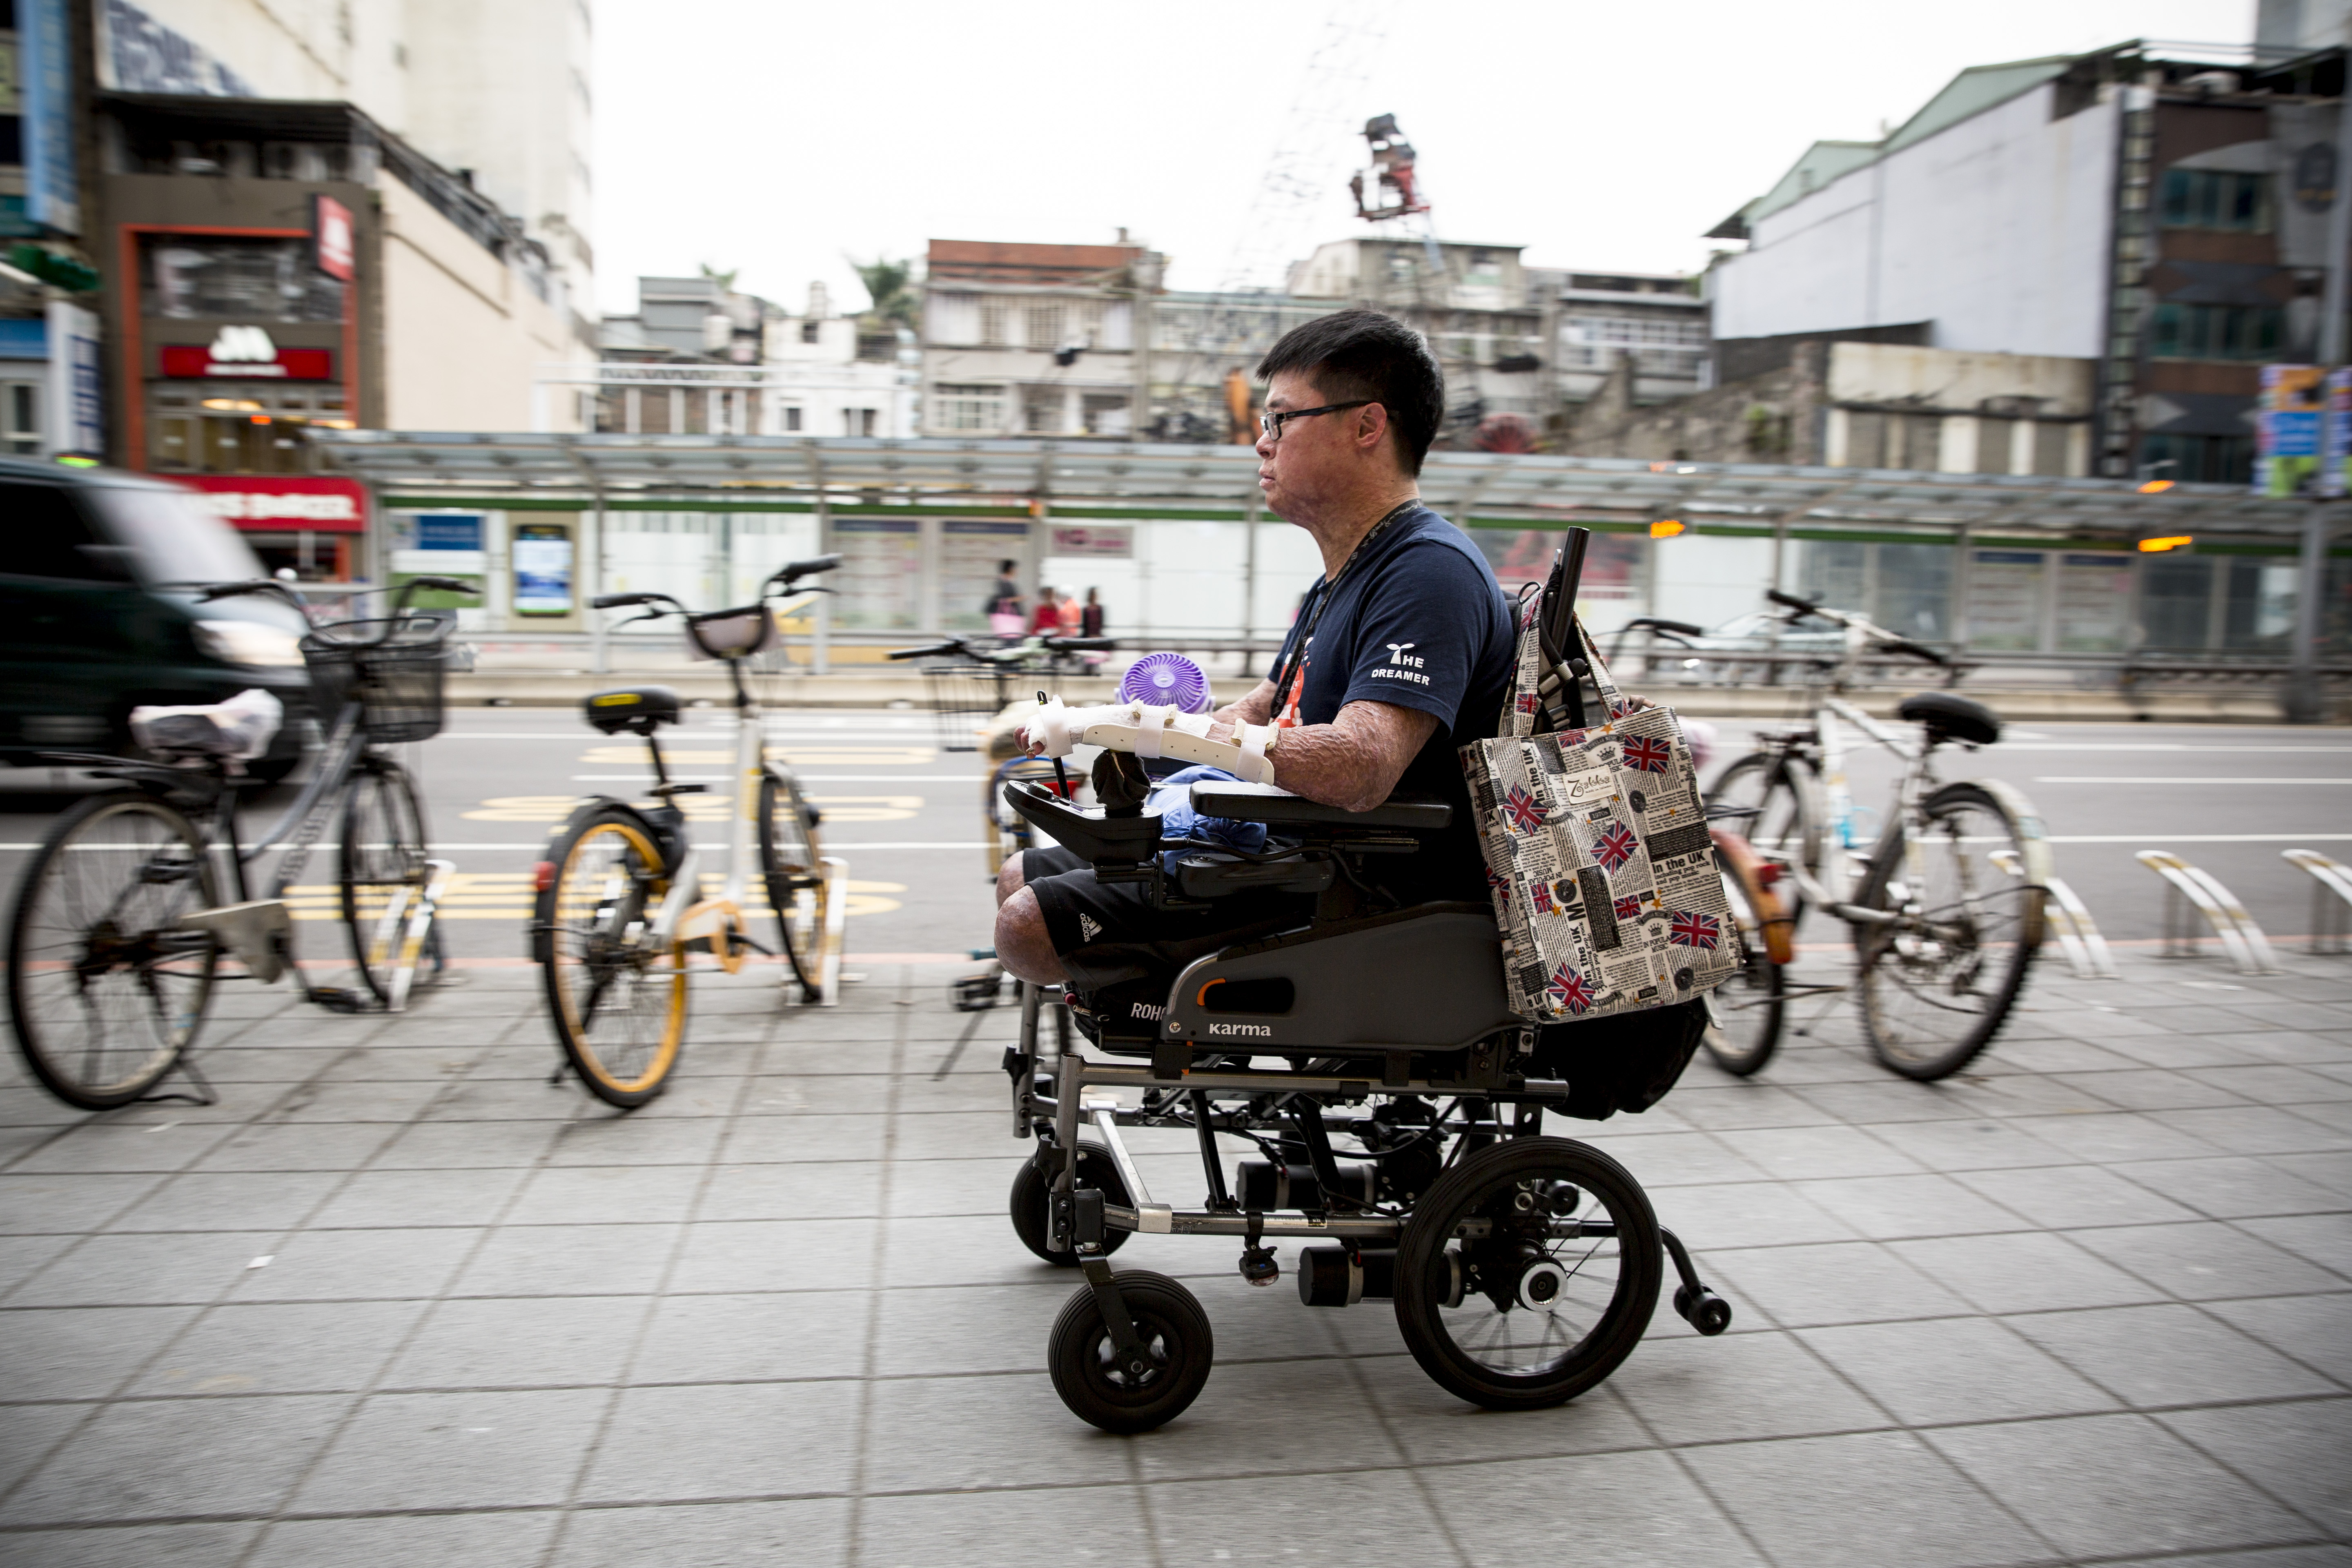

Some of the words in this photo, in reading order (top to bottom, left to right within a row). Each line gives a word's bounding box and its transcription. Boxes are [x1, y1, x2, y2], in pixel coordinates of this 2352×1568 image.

[1386, 643, 1424, 668] THE
[1371, 669, 1430, 686] DREAMER
[1522, 748, 1534, 765] UK
[1529, 767, 1541, 787] the
[1610, 764, 1623, 773] SIC
[1539, 772, 1551, 800] including
[1568, 775, 1610, 797] Zakka
[1652, 863, 1663, 874] In
[1666, 858, 1686, 870] the
[1688, 850, 1706, 864] UK
[1528, 873, 1555, 885] POPULAR
[1533, 867, 1552, 877] MUSIC
[1654, 869, 1682, 880] including
[1080, 913, 1090, 942] adidas
[1570, 926, 1582, 944] UK
[1588, 933, 1596, 951] music
[1650, 935, 1671, 946] POPULA
[1651, 943, 1669, 952] MUSIC
[1578, 947, 1589, 967] the
[1587, 951, 1597, 981] including
[1584, 970, 1592, 983] In
[1533, 992, 1544, 1005] UK
[1209, 1023, 1271, 1036] karma
